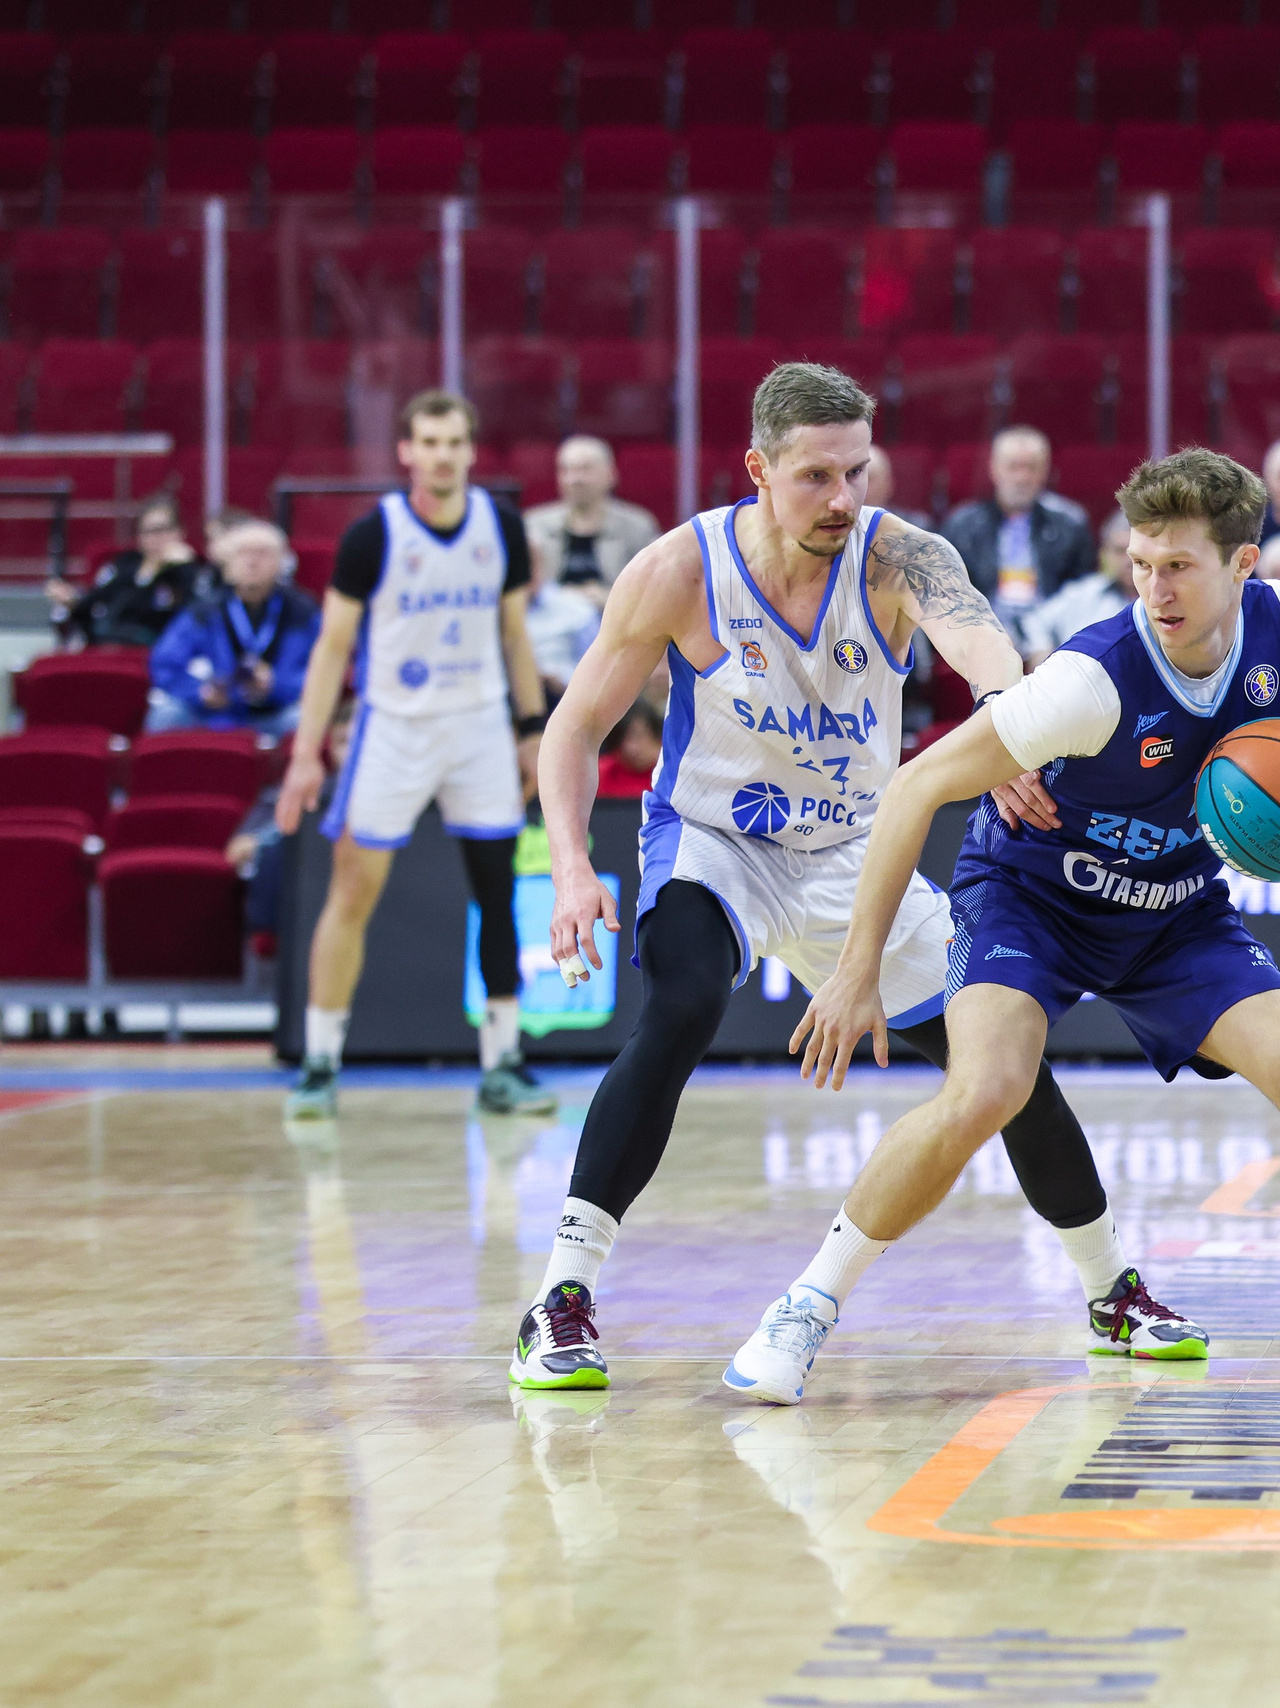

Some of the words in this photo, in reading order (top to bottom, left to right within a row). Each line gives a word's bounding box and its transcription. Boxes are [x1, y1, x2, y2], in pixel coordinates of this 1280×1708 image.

[729, 618, 763, 629] ZEDO
[733, 698, 877, 745] SAMARA
[1148, 743, 1172, 757] WIN
[1085, 812, 1203, 861] ZEN
[1218, 838, 1229, 850] 2.0
[1101, 871, 1205, 910] ГАЗПРОМ
